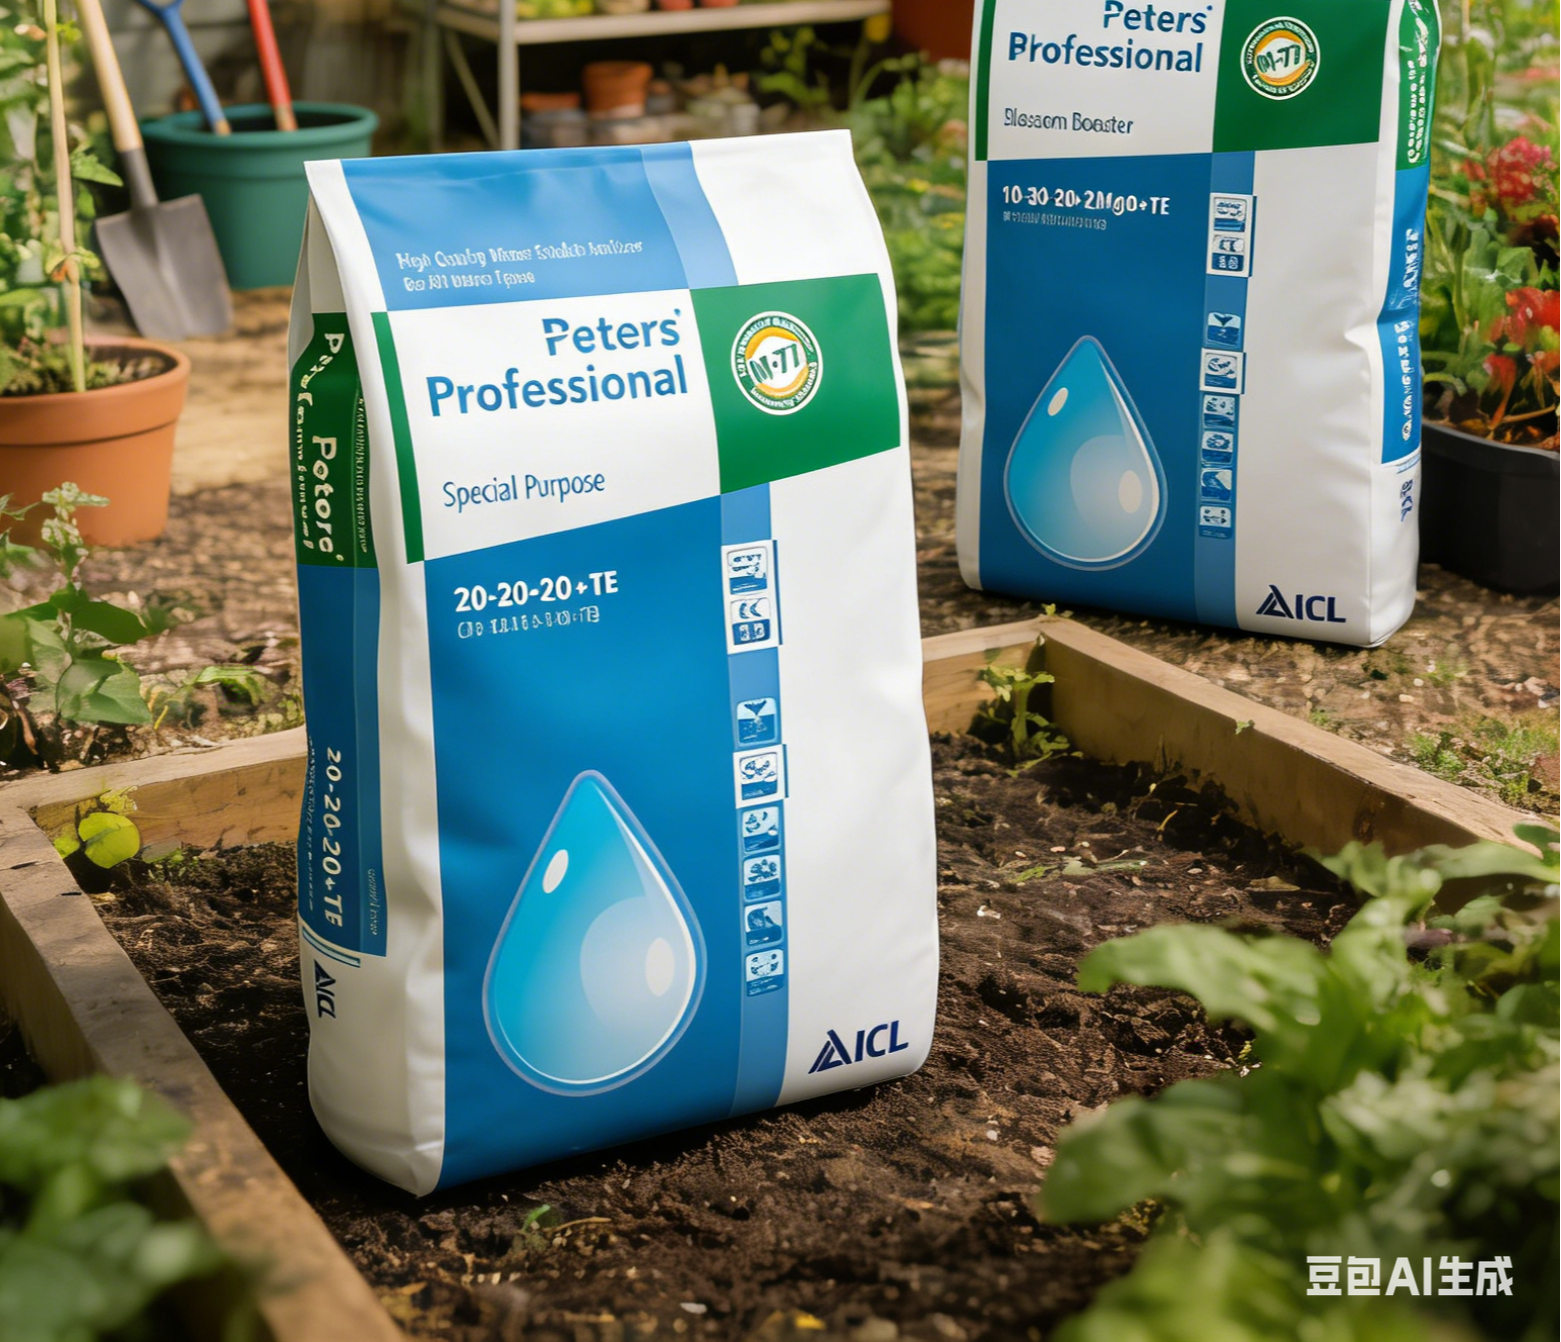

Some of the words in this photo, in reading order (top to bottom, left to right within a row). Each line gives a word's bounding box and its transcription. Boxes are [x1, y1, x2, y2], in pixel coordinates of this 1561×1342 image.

[1008, 31, 1204, 73] Professional
[425, 354, 688, 417] Professional
[442, 474, 518, 514] Special
[524, 473, 606, 503] Purpose
